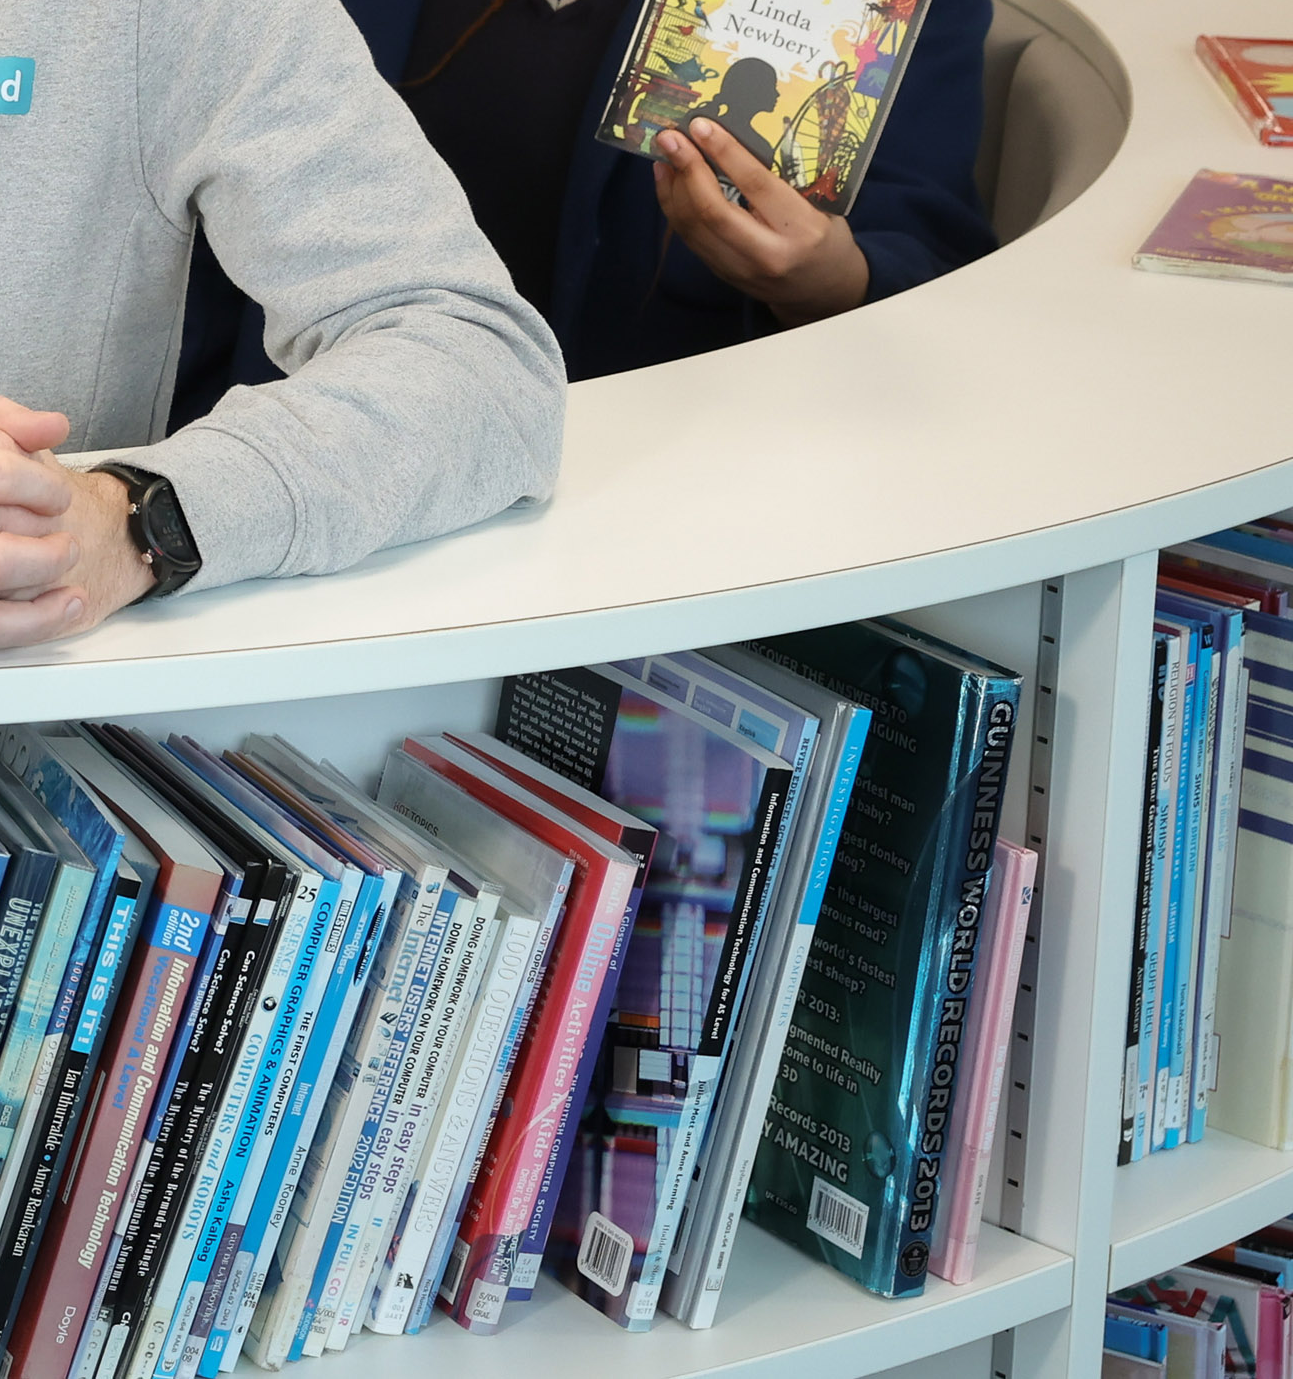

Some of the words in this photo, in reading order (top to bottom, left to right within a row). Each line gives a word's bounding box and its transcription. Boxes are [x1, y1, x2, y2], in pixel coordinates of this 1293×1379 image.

[723, 13, 821, 63] Newbery
[889, 705, 908, 723] TO
[890, 792, 916, 814] man
[966, 700, 1013, 872] GUINNESS
[759, 792, 780, 846] Information
[814, 745, 858, 890] INVESTIGATIONS
[297, 885, 318, 903] 25
[416, 902, 434, 927] The
[737, 867, 760, 936] Communication
[101, 904, 131, 968] THIS
[161, 908, 180, 946] edition
[173, 911, 201, 953] 2nd
[295, 901, 331, 981] COMPUTER
[325, 900, 352, 953] MILESTONES
[415, 910, 450, 984] INTERNET
[444, 922, 463, 955] DOING
[468, 916, 486, 949] DOING
[610, 916, 630, 959] Glossary
[947, 874, 985, 995] WORLD
[216, 949, 231, 971] Can
[241, 950, 256, 973] Can
[386, 927, 426, 1005] Internet
[447, 950, 474, 1007] HOMEWORK
[526, 948, 547, 983] TOPICS
[574, 921, 616, 994] Online
[723, 936, 744, 988] Technology
[91, 975, 109, 1002] IS
[132, 954, 171, 1044] Vocational
[150, 958, 190, 1043] Information
[202, 973, 223, 1015] Science
[226, 974, 247, 1017] Science
[425, 955, 451, 1012] HOMEWORK
[777, 945, 806, 1027] COMPUTERS
[189, 1016, 208, 1054] Solve?
[213, 1018, 233, 1055] Solve?
[271, 985, 302, 1056] GRAPHICS
[413, 1026, 427, 1057] YOUR
[433, 1021, 449, 1050] YOUR
[553, 996, 588, 1088] Activities
[141, 1043, 160, 1076] and
[289, 1033, 305, 1065] FIRST
[454, 988, 511, 1109] QUESTIONS
[840, 1050, 882, 1085] Reality
[112, 1065, 136, 1110] Level
[216, 1033, 263, 1135] COMPUTERS
[364, 1039, 406, 1124] REFERENCE
[392, 1056, 417, 1105] COMPUTER
[416, 1049, 440, 1099] COMPUTER
[921, 999, 964, 1154] RECORDS
[235, 1075, 272, 1158] ANIMATION
[264, 1067, 294, 1136] COMPUTERS
[291, 1082, 312, 1116] Internet
[107, 1073, 154, 1186] Communication
[352, 1134, 372, 1170] 2002
[370, 1127, 393, 1161] easy
[394, 1120, 417, 1154] easy
[532, 1116, 556, 1159] Kids
[819, 1125, 851, 1153] 2013
[32, 1163, 52, 1195] Anne
[289, 1144, 307, 1176] Anne
[382, 1155, 405, 1195] steps
[540, 1135, 562, 1194] COMPUTER
[774, 1127, 850, 1184] AMAZING
[154, 1180, 179, 1232] Bermuda
[216, 1180, 235, 1213] Asha
[269, 1183, 295, 1229] Rooney
[331, 1171, 360, 1225] EDITION
[359, 1162, 382, 1201] steps
[413, 1132, 456, 1234] ANSWERS
[908, 1158, 939, 1232] 2013
[12, 1196, 43, 1257] Ramkaran
[78, 1187, 119, 1269] Technology
[126, 1180, 153, 1239] Abominable
[181, 1175, 213, 1241] ROBOTS
[528, 1198, 546, 1241] SOCIETY
[137, 1232, 163, 1278] Triangle
[197, 1215, 224, 1263] Kalbag
[108, 1239, 135, 1292] Snowman
[56, 1305, 77, 1345] Doyle
